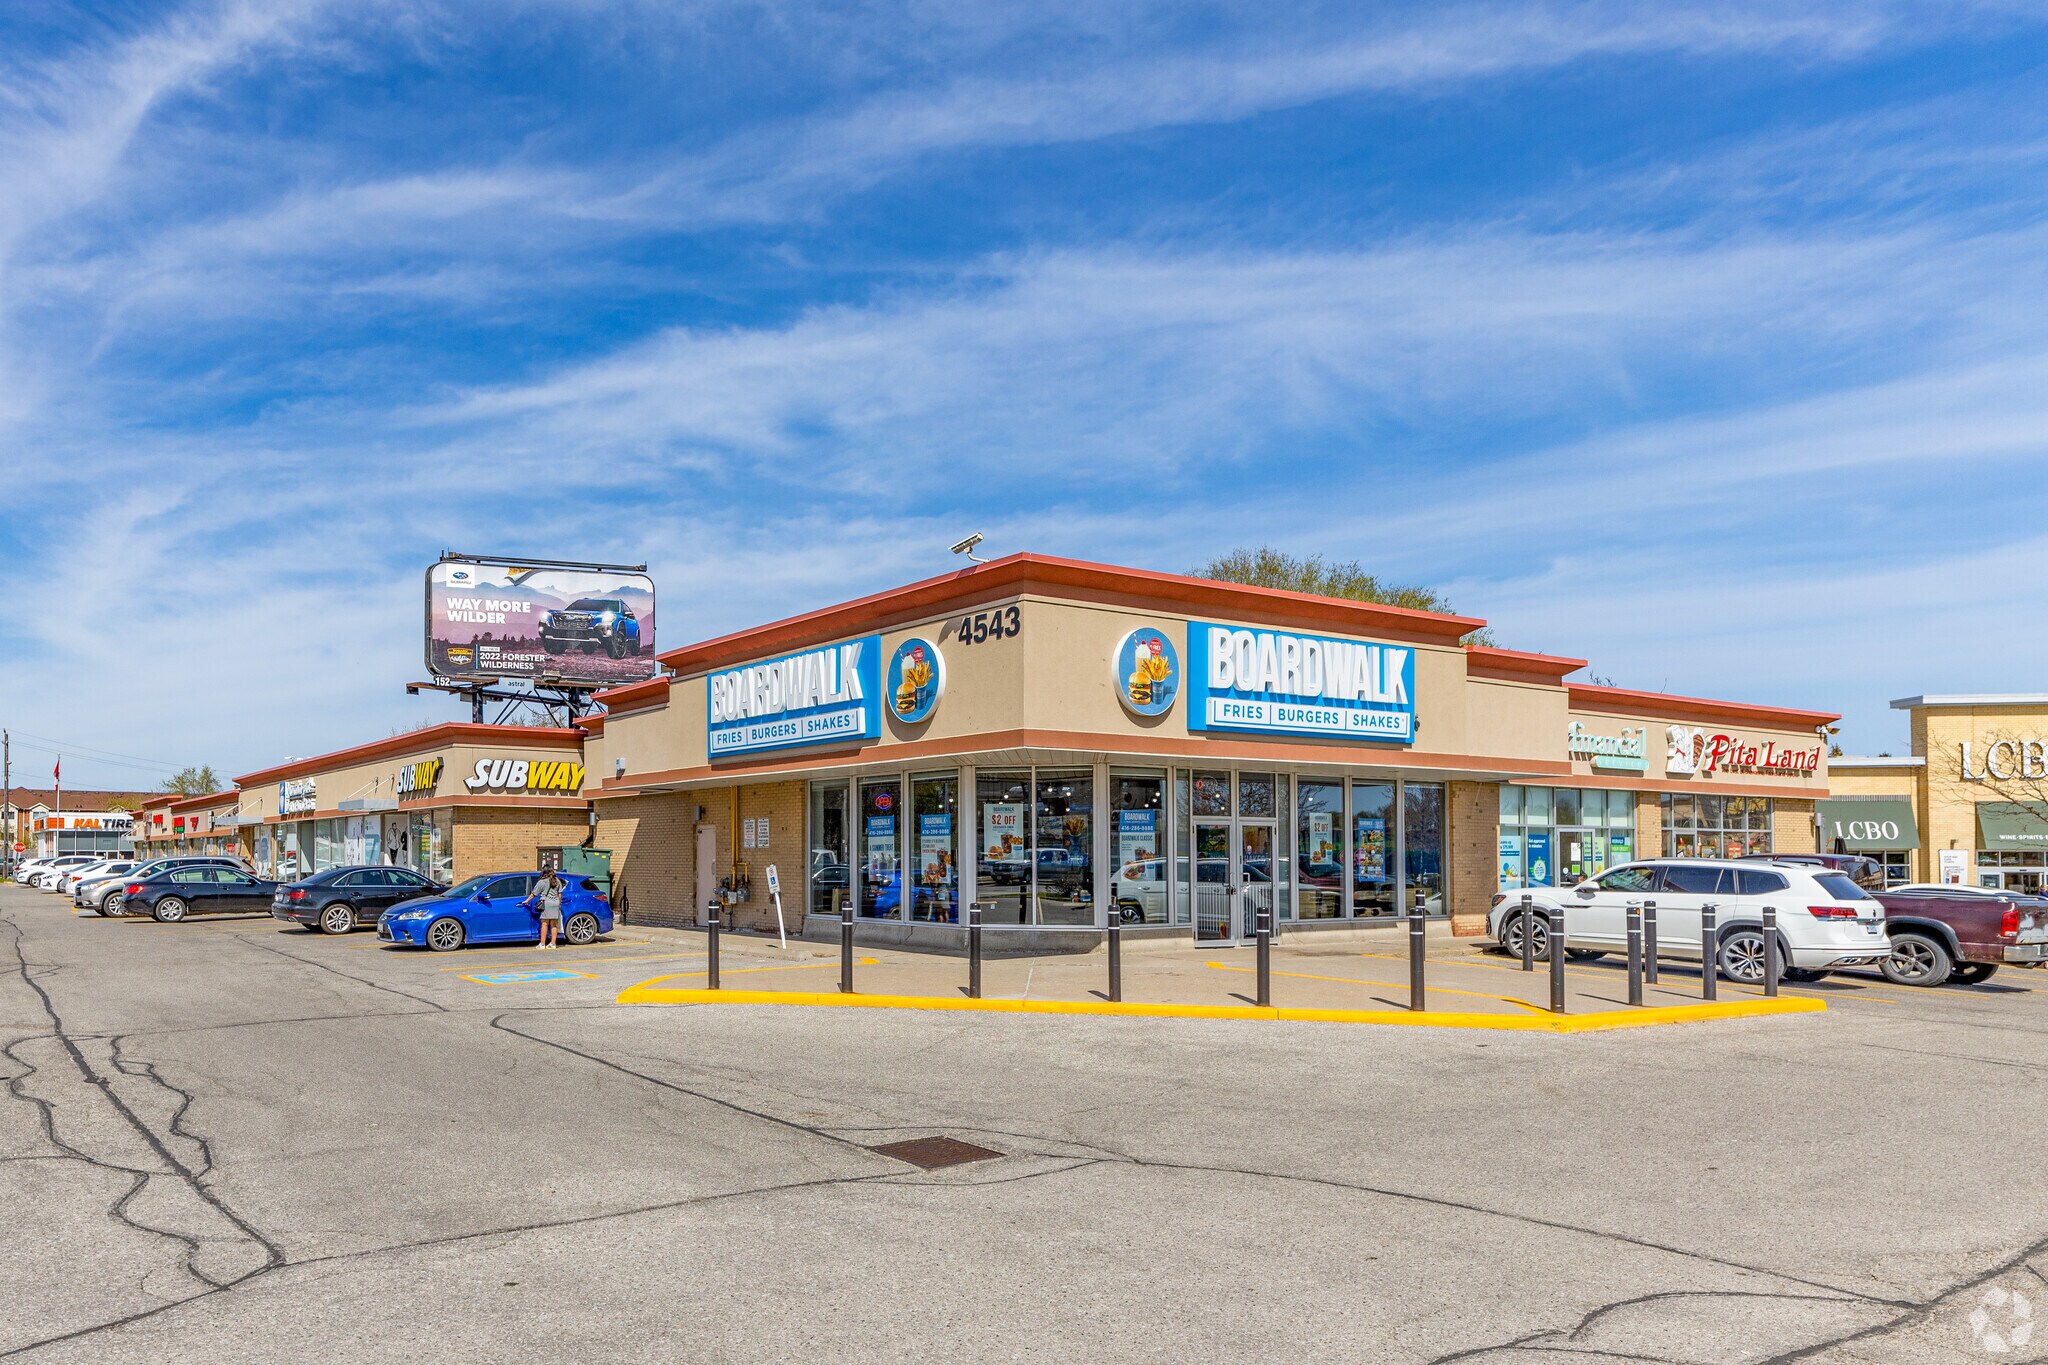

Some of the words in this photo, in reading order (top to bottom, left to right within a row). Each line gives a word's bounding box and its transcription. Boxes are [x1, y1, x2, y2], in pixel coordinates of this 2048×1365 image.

[447, 597, 482, 610] WAY
[485, 599, 531, 613] MORE
[447, 610, 506, 624] WILDER
[959, 606, 1021, 646] 4543
[480, 652, 501, 661] 2022
[502, 653, 546, 662] FORESTER
[480, 660, 534, 670] WILDERNESS
[1208, 627, 1408, 704] BOARDWALK
[435, 676, 450, 686] 152
[711, 642, 863, 724] BOARDWALK
[1223, 704, 1263, 719] FRIES
[1278, 708, 1339, 725] BURGERS
[1352, 714, 1400, 729] SHAKES
[717, 731, 742, 745] FRIES
[752, 723, 797, 740] BURGERS
[807, 714, 850, 732] SHAKES
[1708, 734, 1757, 771] Pita
[1763, 741, 1820, 771] Land
[1961, 740, 2048, 782] LCB
[397, 757, 443, 794] SUBWAY
[463, 758, 584, 790] SUBWAY
[73, 818, 102, 829] KAL
[103, 818, 132, 829] TIRE
[991, 814, 1002, 825] $2
[1004, 815, 1016, 825] OFF
[1124, 812, 1150, 821] BOARDWALK
[1314, 822, 1320, 832] $2
[1834, 820, 1899, 840] LCBO
